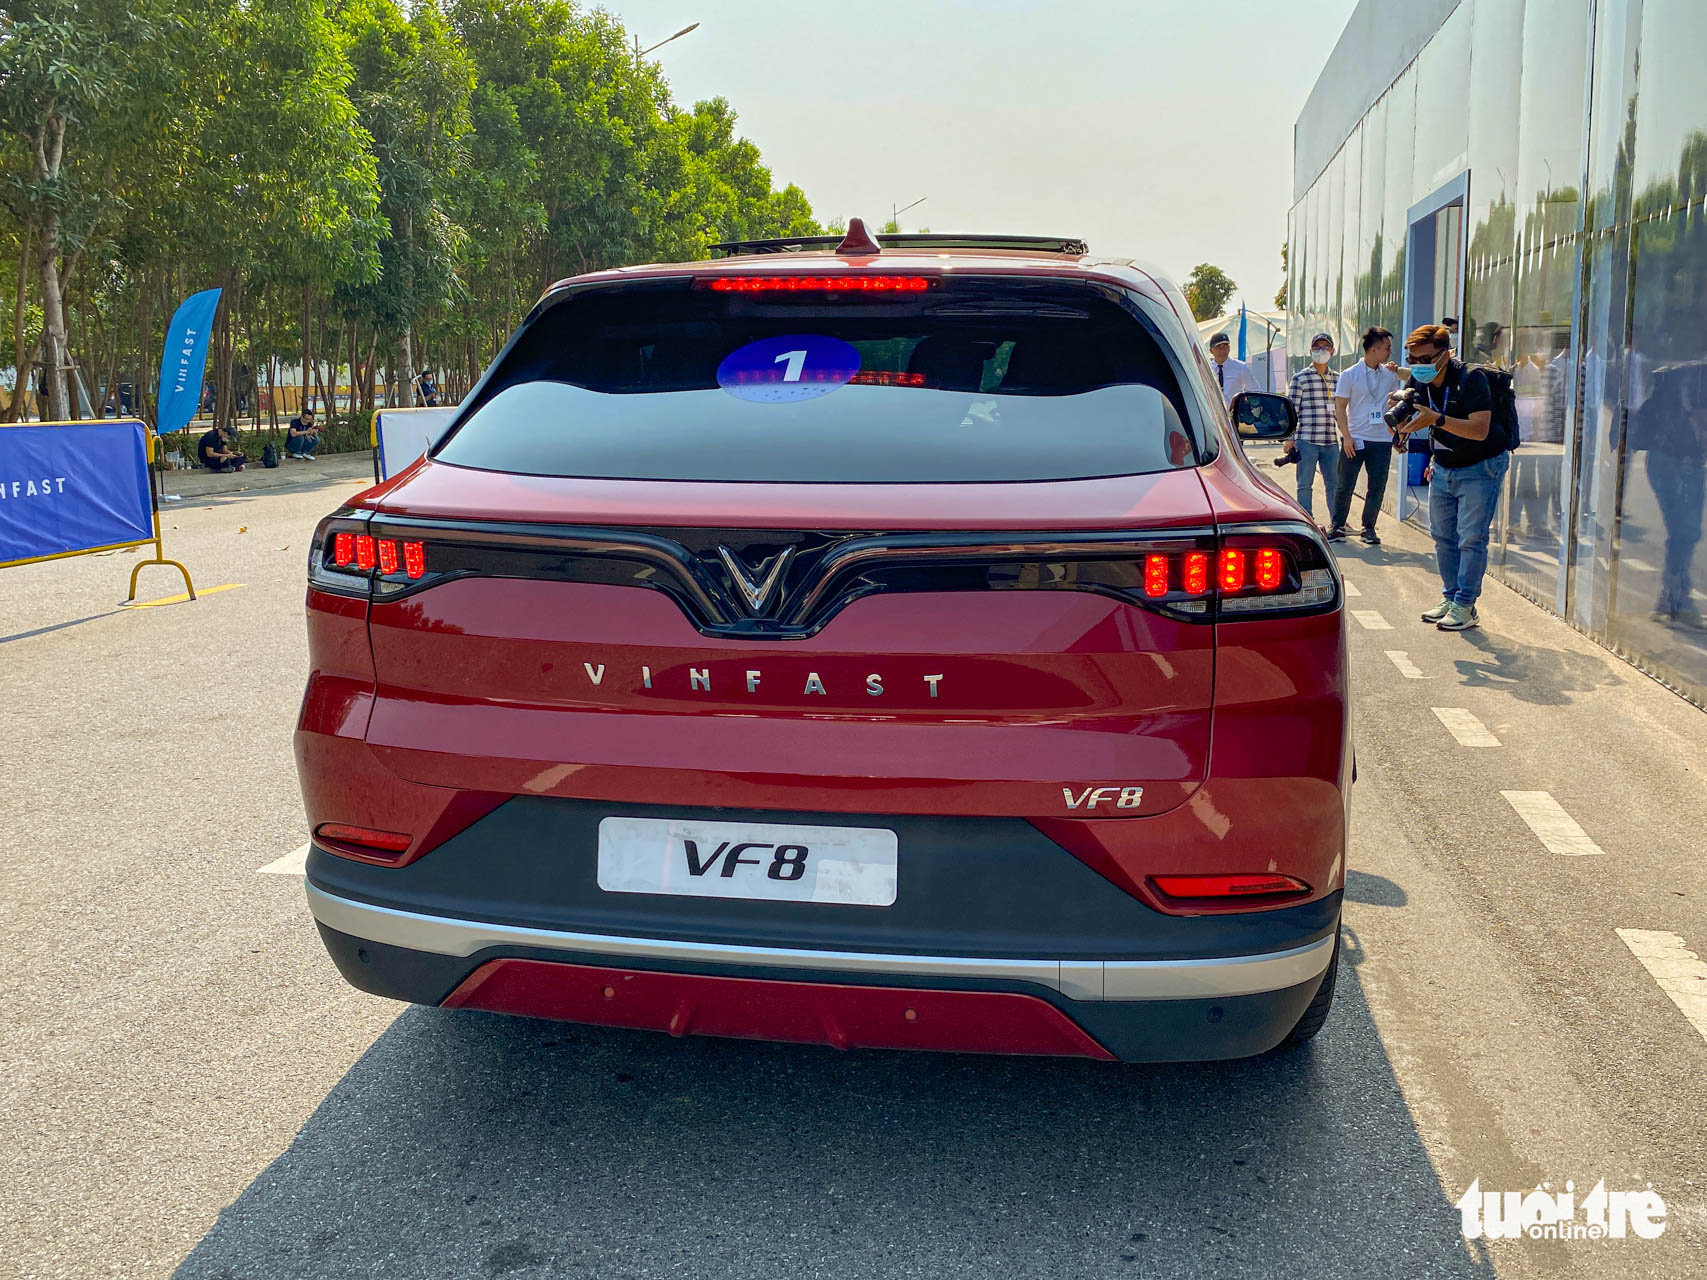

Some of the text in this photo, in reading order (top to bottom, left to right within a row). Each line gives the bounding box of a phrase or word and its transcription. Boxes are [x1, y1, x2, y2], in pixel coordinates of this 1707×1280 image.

[174, 328, 197, 393] VINFAST
[774, 350, 808, 382] 1
[1370, 411, 1382, 419] 18
[583, 662, 944, 698] VINFAST
[1062, 786, 1145, 810] VF8
[684, 839, 810, 881] VF8
